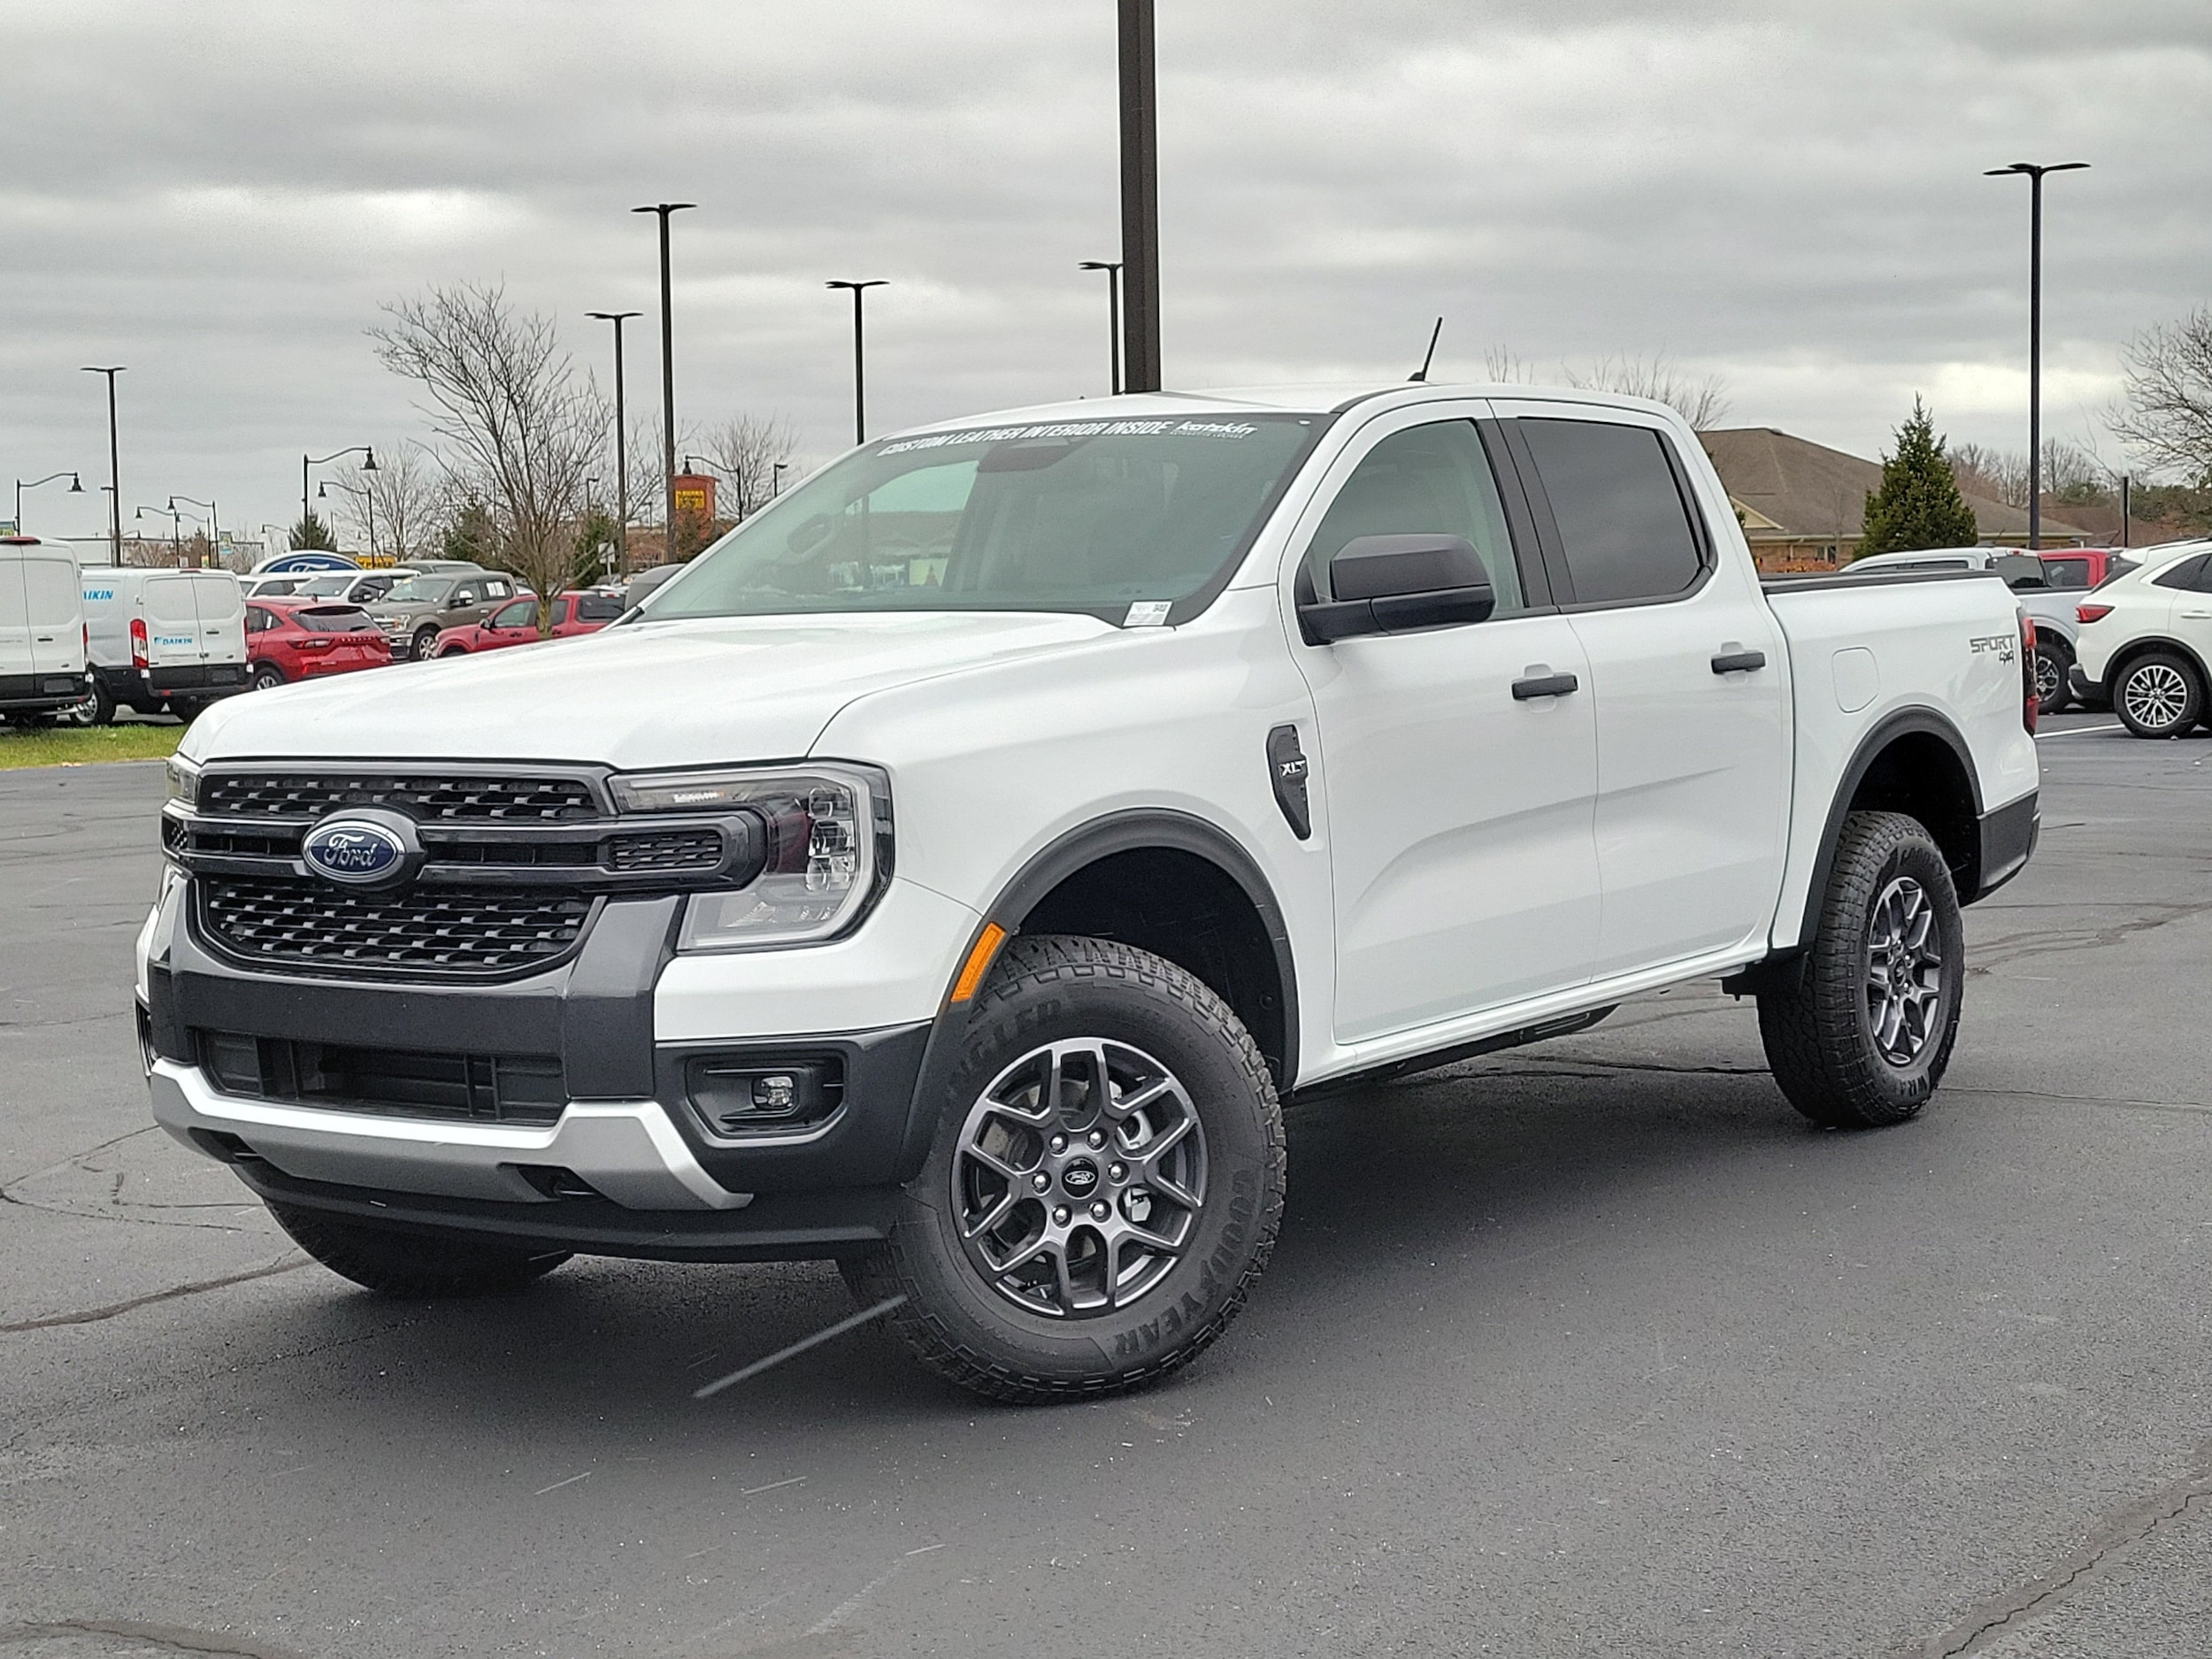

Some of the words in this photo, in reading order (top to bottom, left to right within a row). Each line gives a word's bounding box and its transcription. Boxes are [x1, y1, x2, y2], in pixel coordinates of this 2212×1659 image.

[876, 434, 949, 457] CUSTOM
[946, 426, 1028, 445] LEATHER
[1018, 422, 1110, 439] INTERIOR
[1102, 420, 1174, 435] INSIDE
[162, 637, 193, 646] DAIKIN
[1970, 634, 2015, 653] SPORT
[1280, 759, 1307, 777] XLT
[324, 833, 379, 867] Ford
